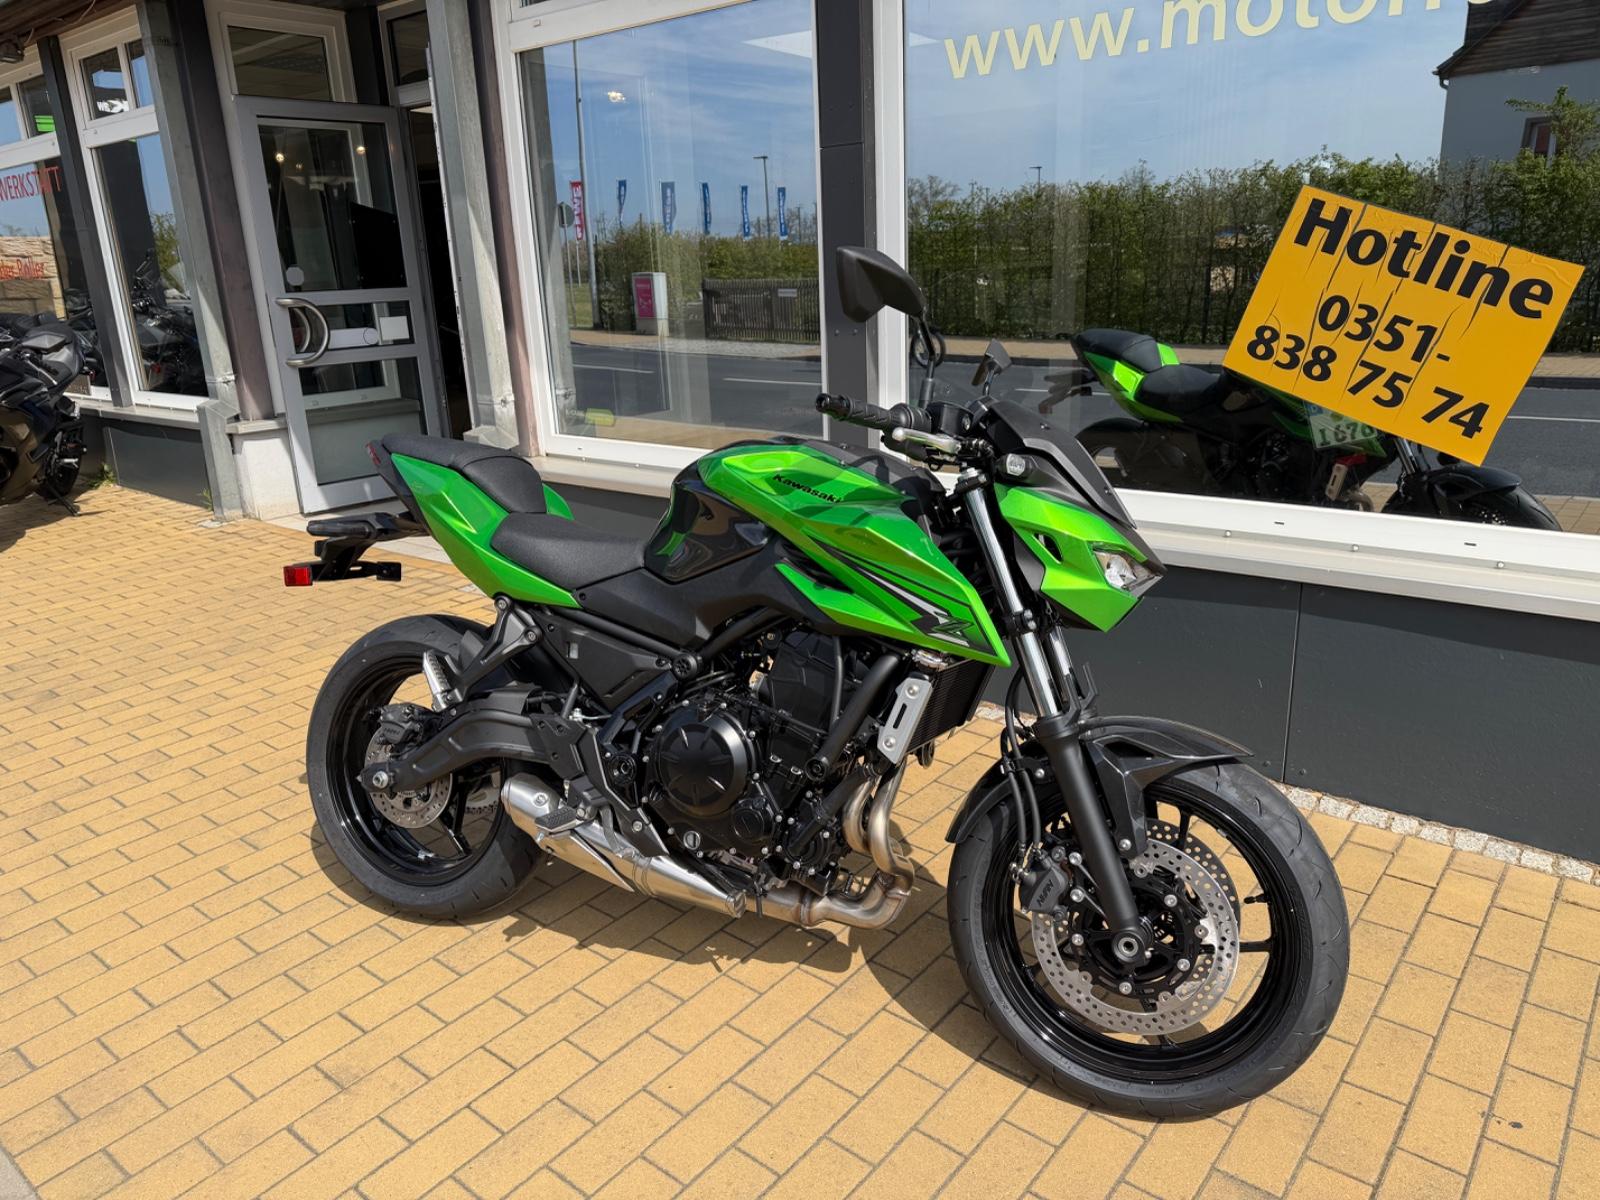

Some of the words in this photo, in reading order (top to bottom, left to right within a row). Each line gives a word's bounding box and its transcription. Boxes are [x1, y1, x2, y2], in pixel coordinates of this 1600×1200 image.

[1294, 198, 1553, 319] Hotline
[1318, 295, 1450, 363] 0351-
[1247, 325, 1337, 382] 838
[1347, 359, 1413, 408] 75
[1421, 386, 1490, 439] 74
[772, 474, 842, 503] Kawasaki
